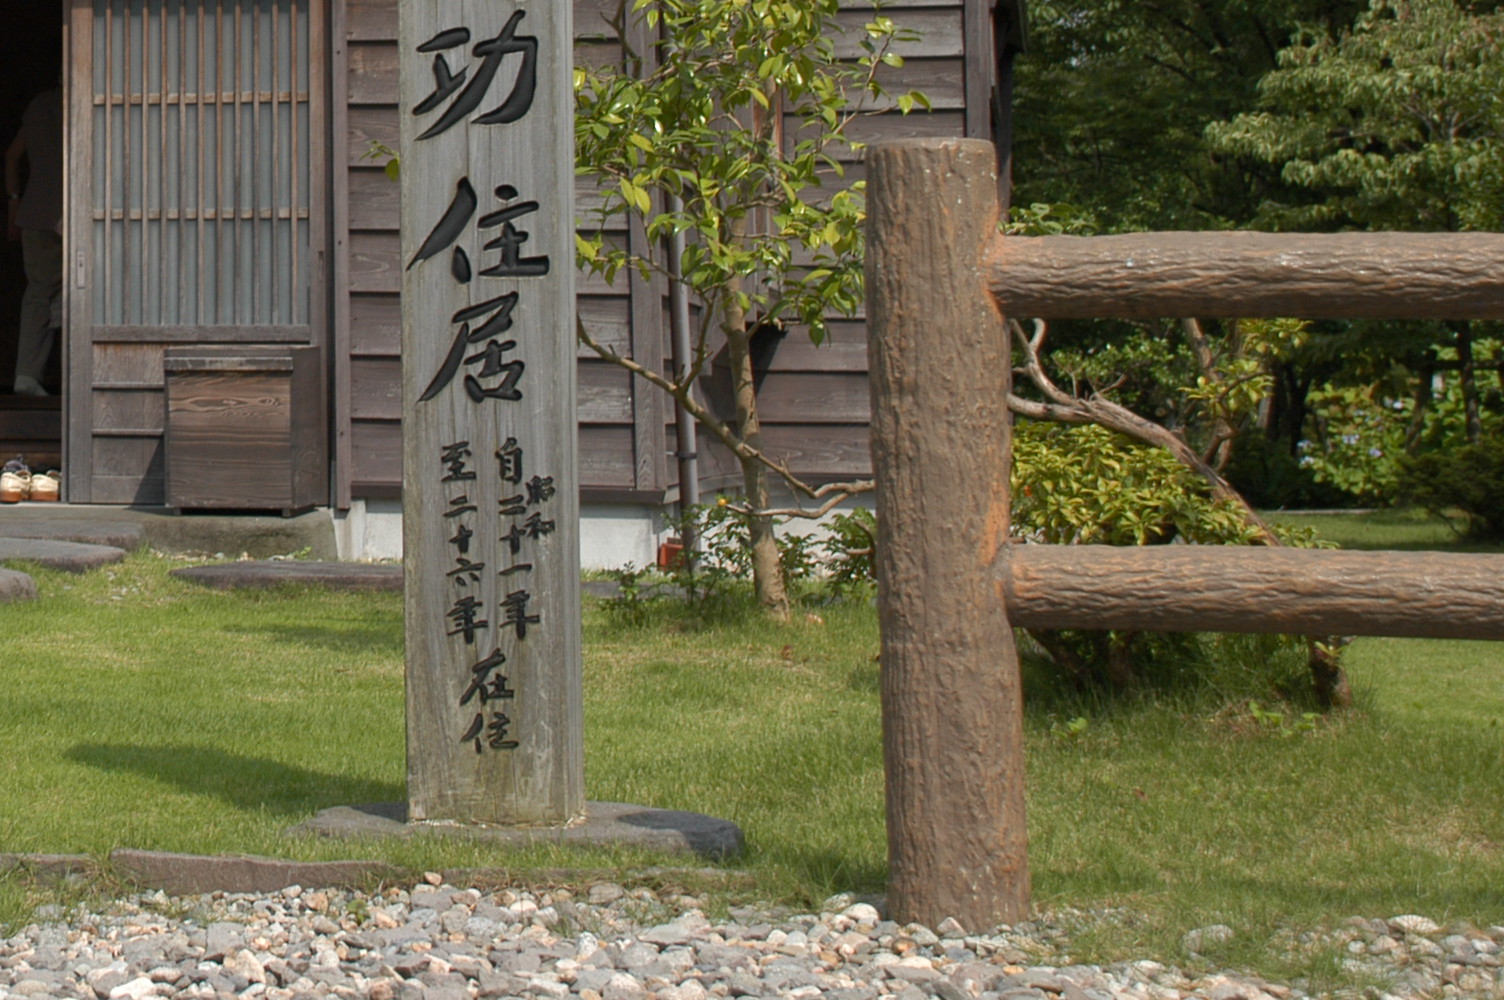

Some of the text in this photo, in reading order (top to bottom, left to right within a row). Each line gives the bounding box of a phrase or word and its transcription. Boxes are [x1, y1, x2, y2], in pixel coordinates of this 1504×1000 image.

[440, 440, 490, 645] 至二十六年
[459, 647, 520, 754] 在住
